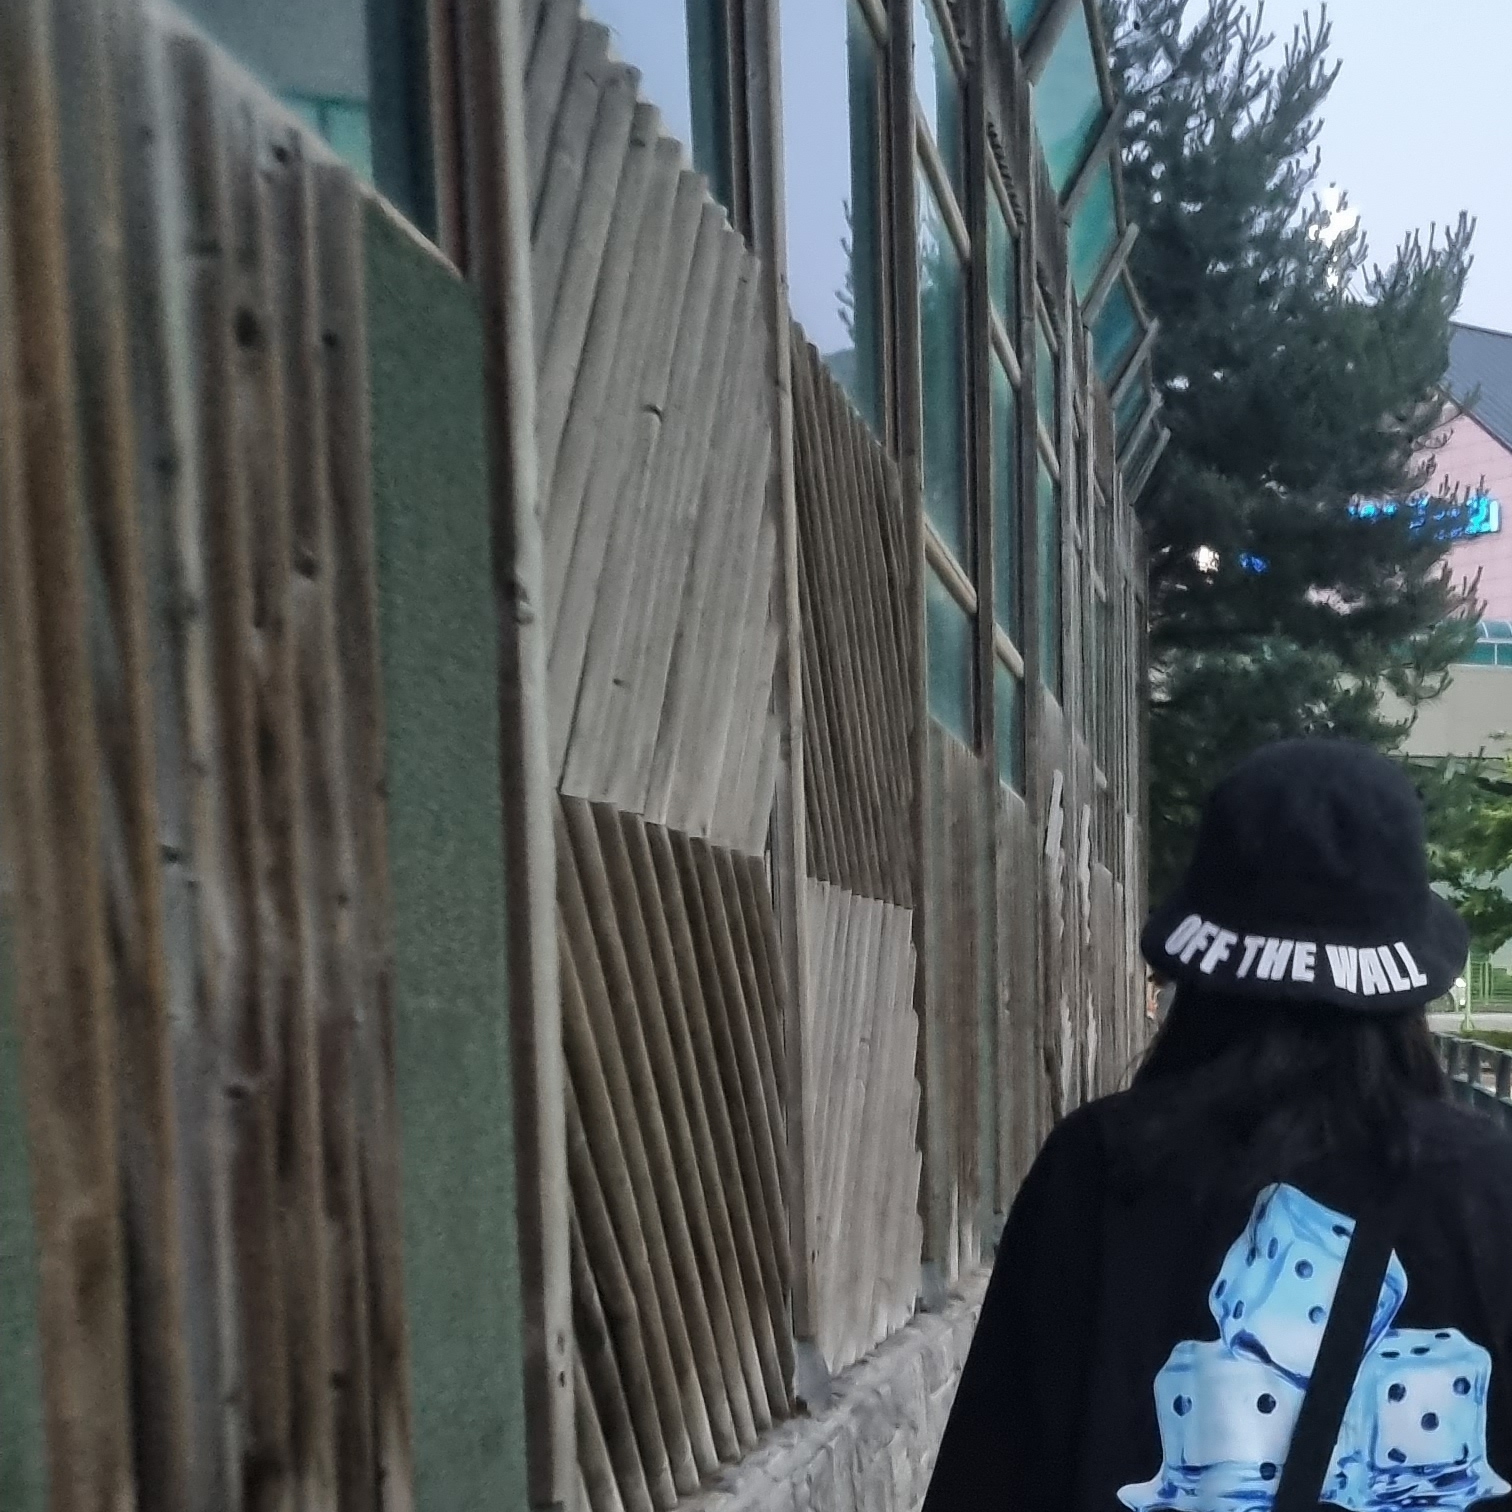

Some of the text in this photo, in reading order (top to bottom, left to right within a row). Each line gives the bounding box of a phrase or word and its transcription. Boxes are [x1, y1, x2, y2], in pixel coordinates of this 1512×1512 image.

[1164, 913, 1428, 996] OFF THE WALL
